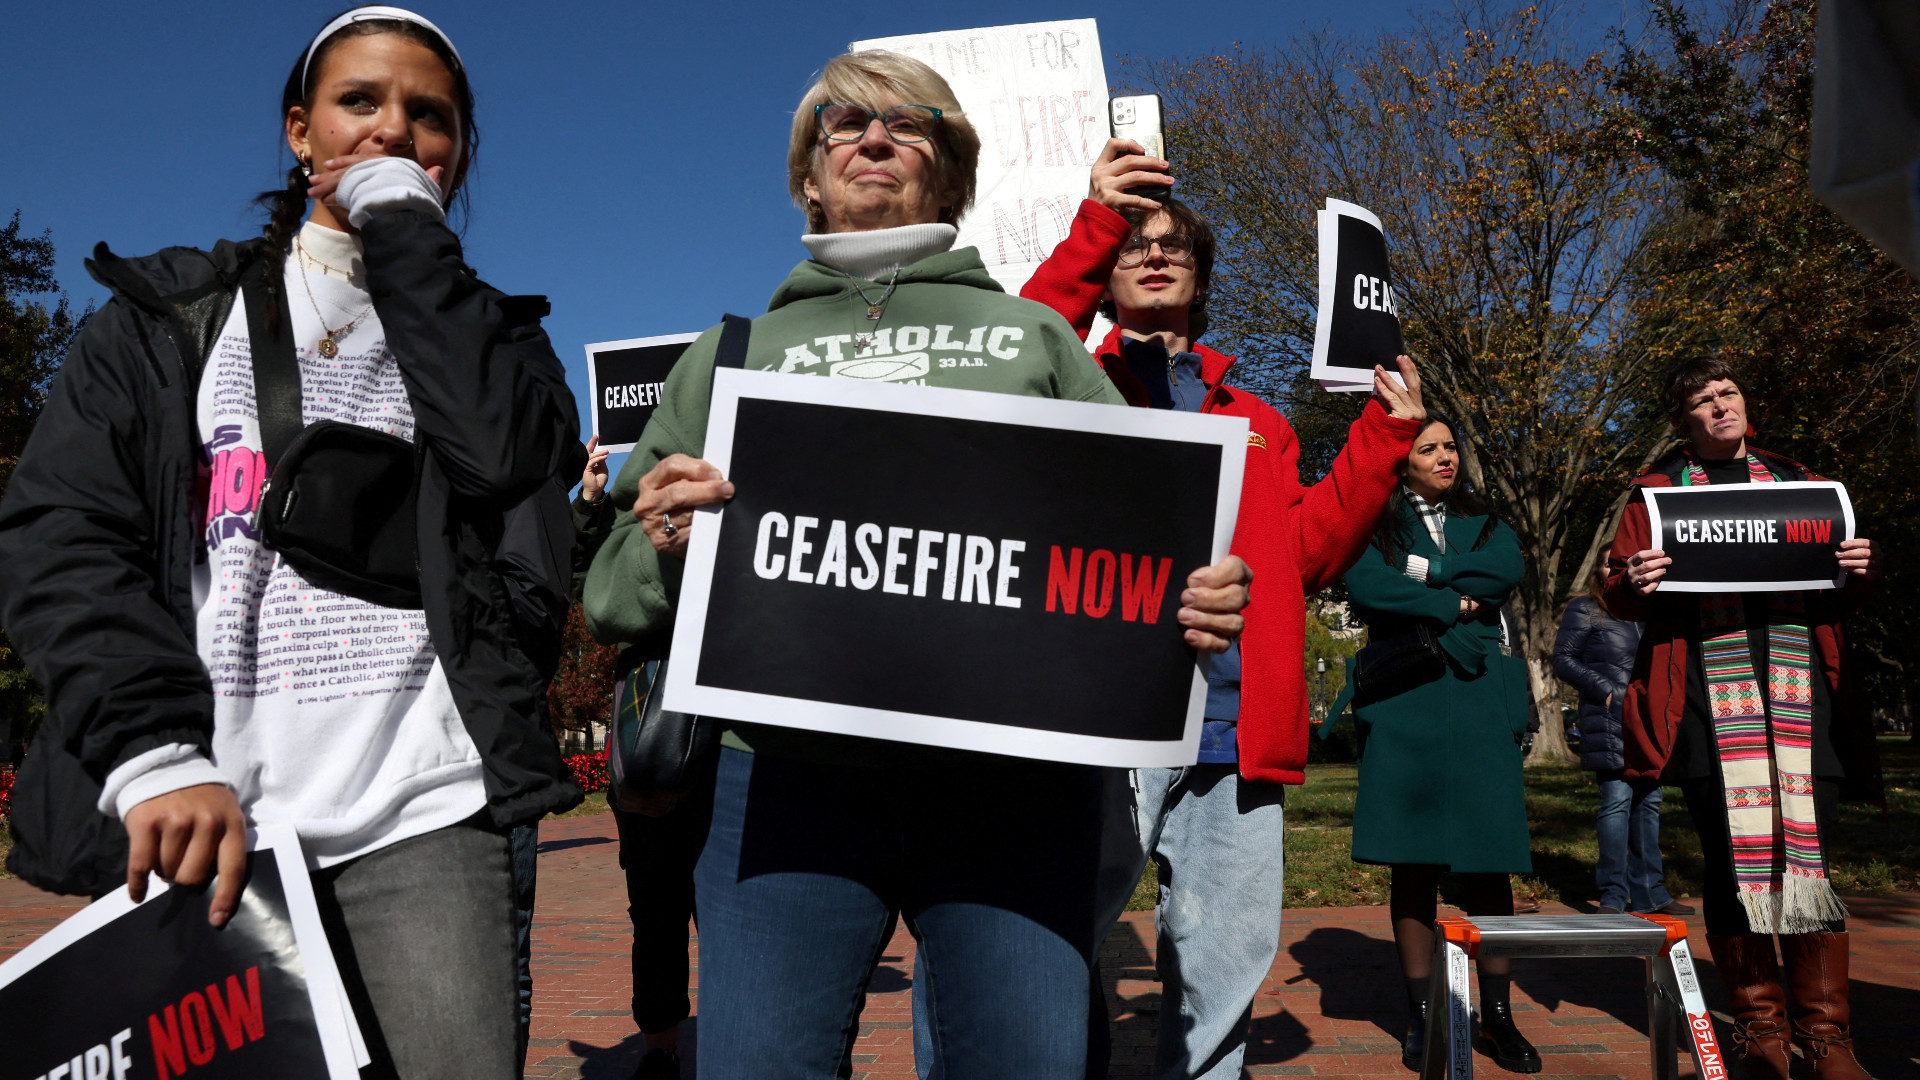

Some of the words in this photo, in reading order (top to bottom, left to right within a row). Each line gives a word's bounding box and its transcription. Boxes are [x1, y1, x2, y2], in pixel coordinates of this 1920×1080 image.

[1025, 29, 1083, 73] FOR
[762, 324, 1025, 374] ATHOLIC
[938, 357, 957, 369] 33
[960, 356, 989, 368] A.D.
[217, 370, 253, 381] Advent
[303, 367, 321, 377] Why
[324, 370, 339, 378] did
[353, 374, 381, 387] giving
[216, 379, 253, 390] Knights
[306, 378, 342, 387] Angelus
[352, 382, 404, 395] processions
[376, 396, 385, 404] of
[386, 395, 400, 403] the
[604, 381, 666, 409] CEASEFI
[376, 416, 414, 429] scapulars
[1675, 519, 1779, 543] CEASEFIRE
[1785, 519, 1832, 544] NOW
[753, 511, 1026, 609] CEASEFIRE
[1044, 544, 1173, 625] NOW
[275, 605, 304, 616] Blaise
[267, 618, 295, 630] touch
[301, 617, 317, 626] the
[321, 615, 346, 625] floor
[350, 612, 377, 621] when
[381, 613, 398, 623] you
[292, 628, 331, 641] corporal
[333, 625, 360, 636] works
[362, 624, 372, 634] of
[374, 624, 400, 634] mercy
[273, 643, 310, 655] maxima
[313, 640, 339, 651] culpa
[351, 636, 373, 648] Holy
[376, 634, 406, 645] Orders
[270, 657, 295, 668] when
[297, 657, 314, 667] you
[317, 653, 337, 664] pass
[346, 648, 384, 659] Catholic
[386, 644, 415, 655] church
[292, 667, 318, 677] what
[320, 665, 339, 673] was
[341, 663, 352, 672] in
[352, 662, 368, 671] the
[369, 660, 395, 670] letter
[396, 657, 405, 666] to
[293, 681, 318, 690] once
[328, 671, 376, 685] Catholic,
[147, 965, 266, 1080] NOW
